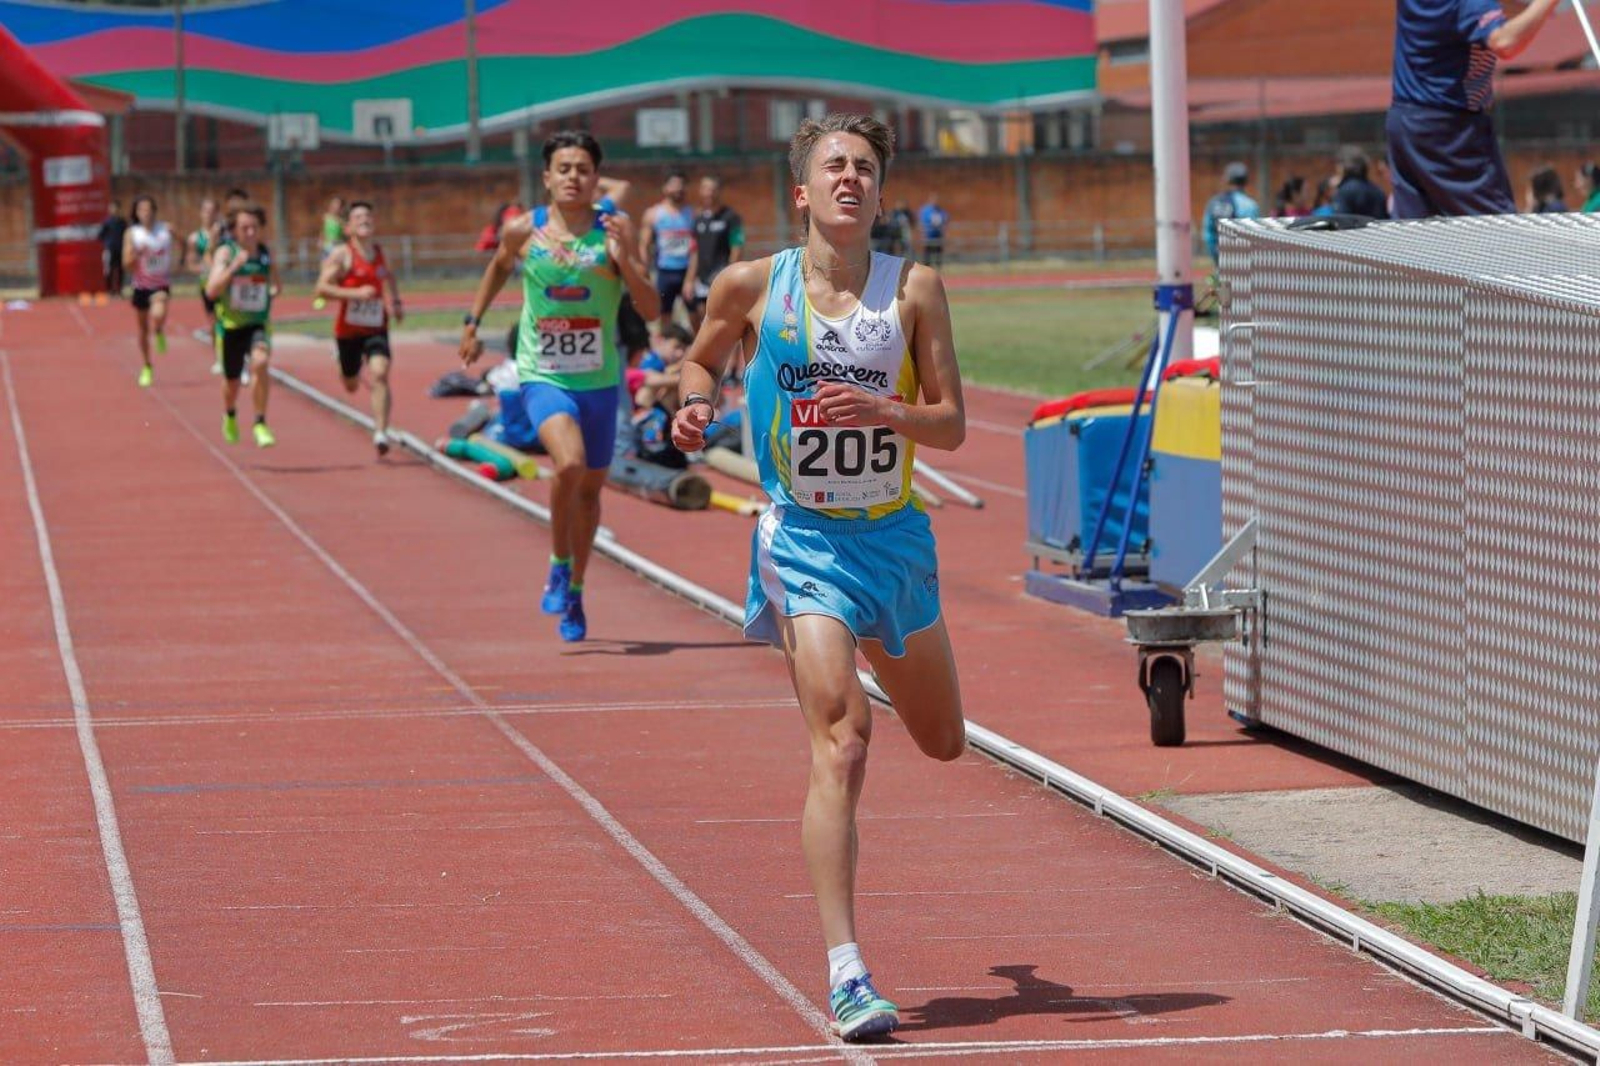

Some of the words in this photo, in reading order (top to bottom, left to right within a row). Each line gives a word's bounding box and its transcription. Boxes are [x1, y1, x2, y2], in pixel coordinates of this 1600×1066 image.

[541, 332, 597, 356] 282
[777, 362, 888, 393] Quescrem
[798, 427, 897, 477] 205
